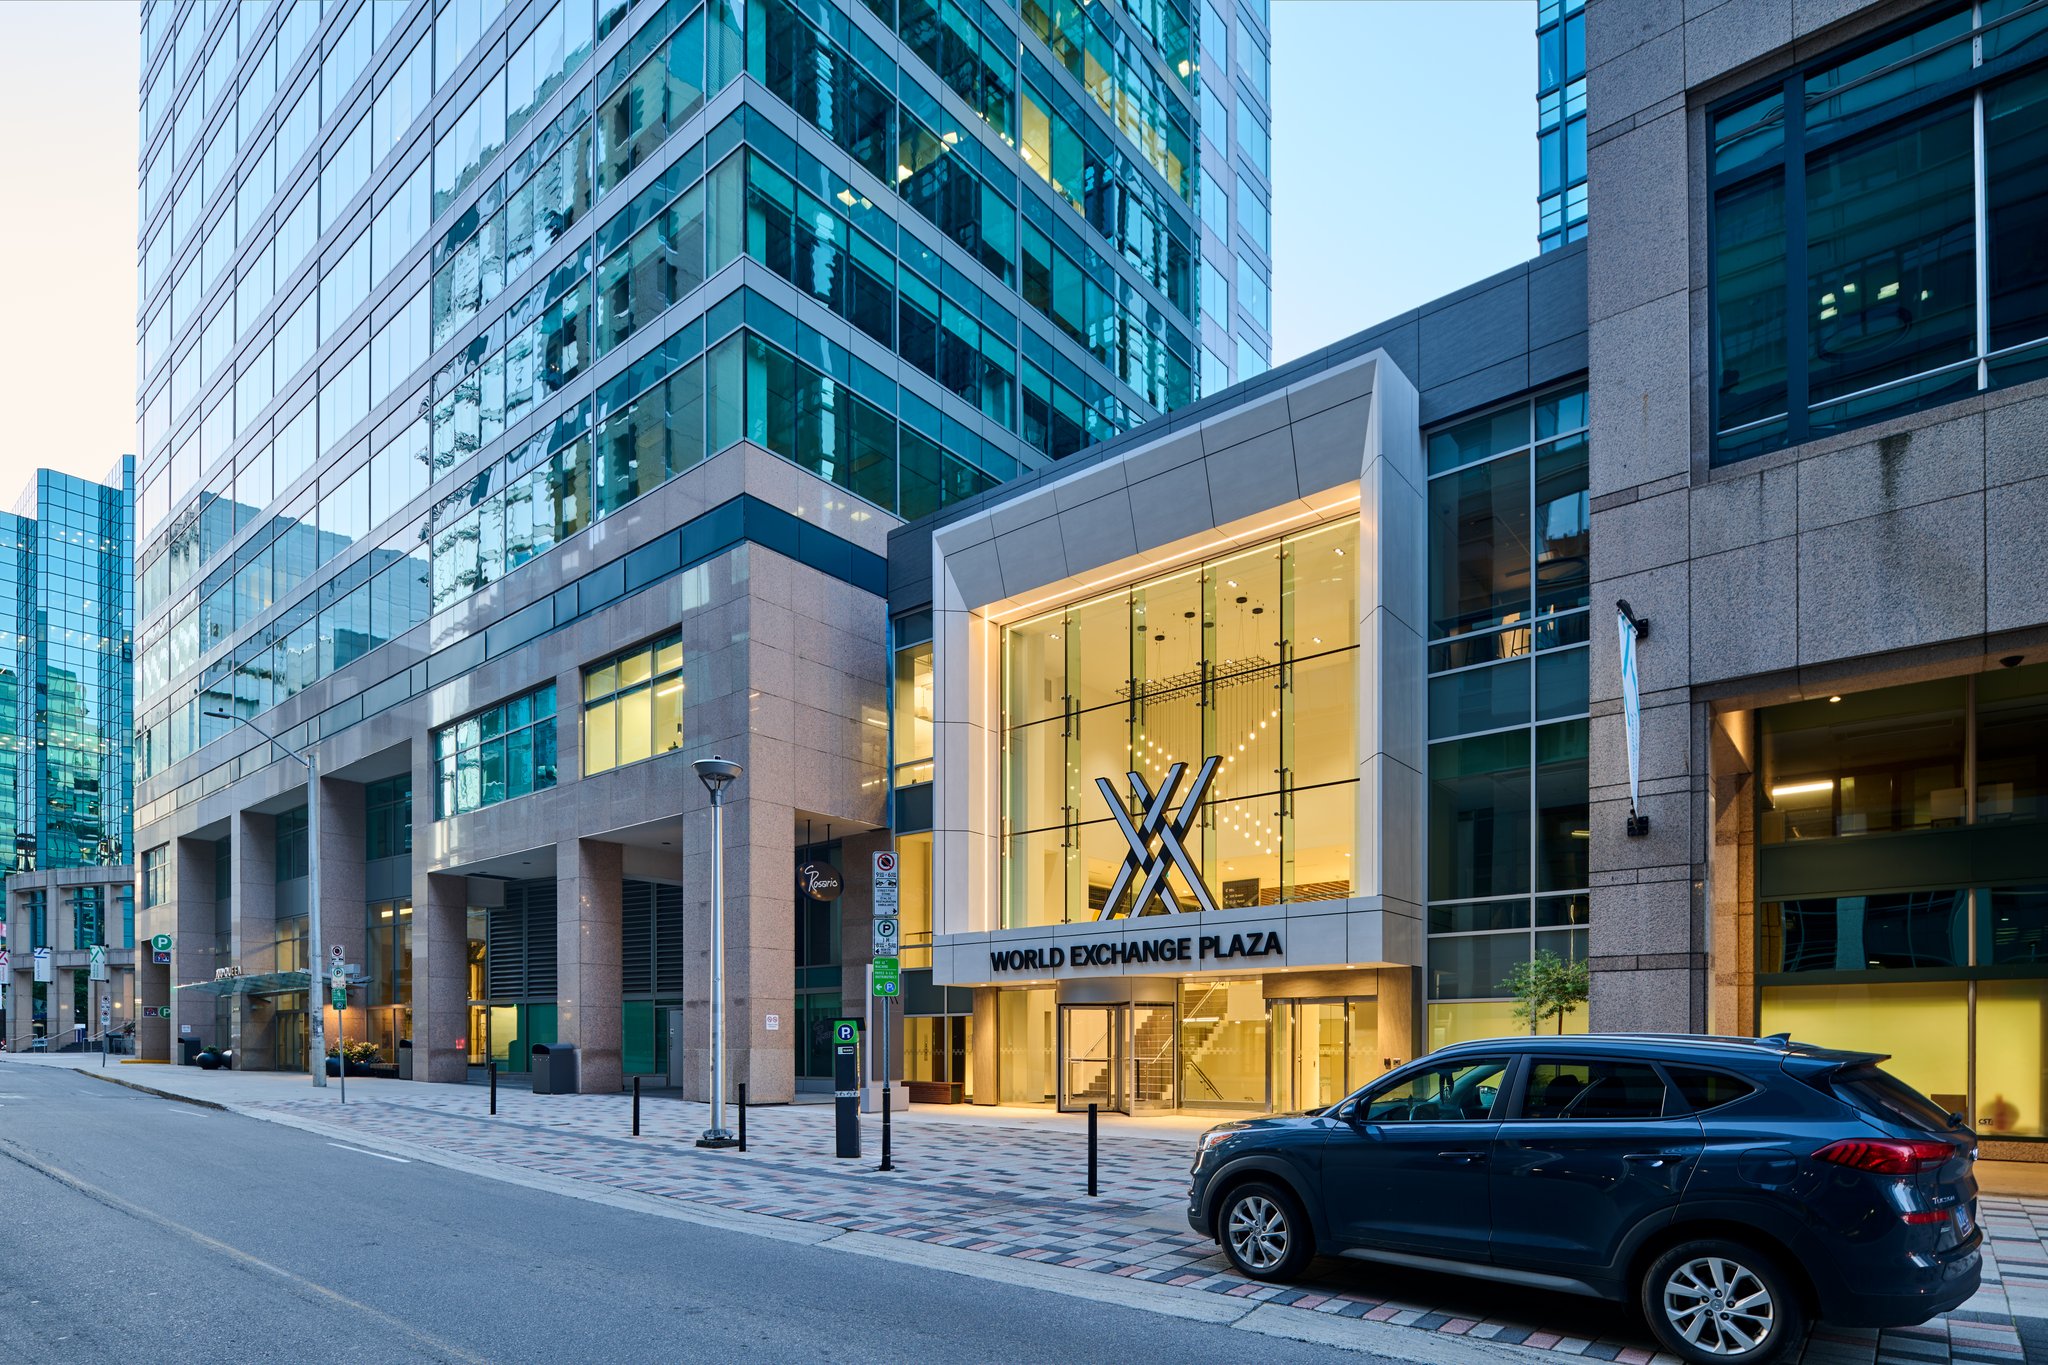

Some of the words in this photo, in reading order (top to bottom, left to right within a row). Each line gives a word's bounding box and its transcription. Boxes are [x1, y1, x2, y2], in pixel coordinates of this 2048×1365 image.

[804, 864, 838, 893] Rosario
[882, 924, 891, 934] P
[158, 937, 168, 948] P
[990, 947, 1065, 972] WORLD
[1070, 937, 1192, 967] EXCHANGE
[1198, 931, 1283, 959] PLAZA
